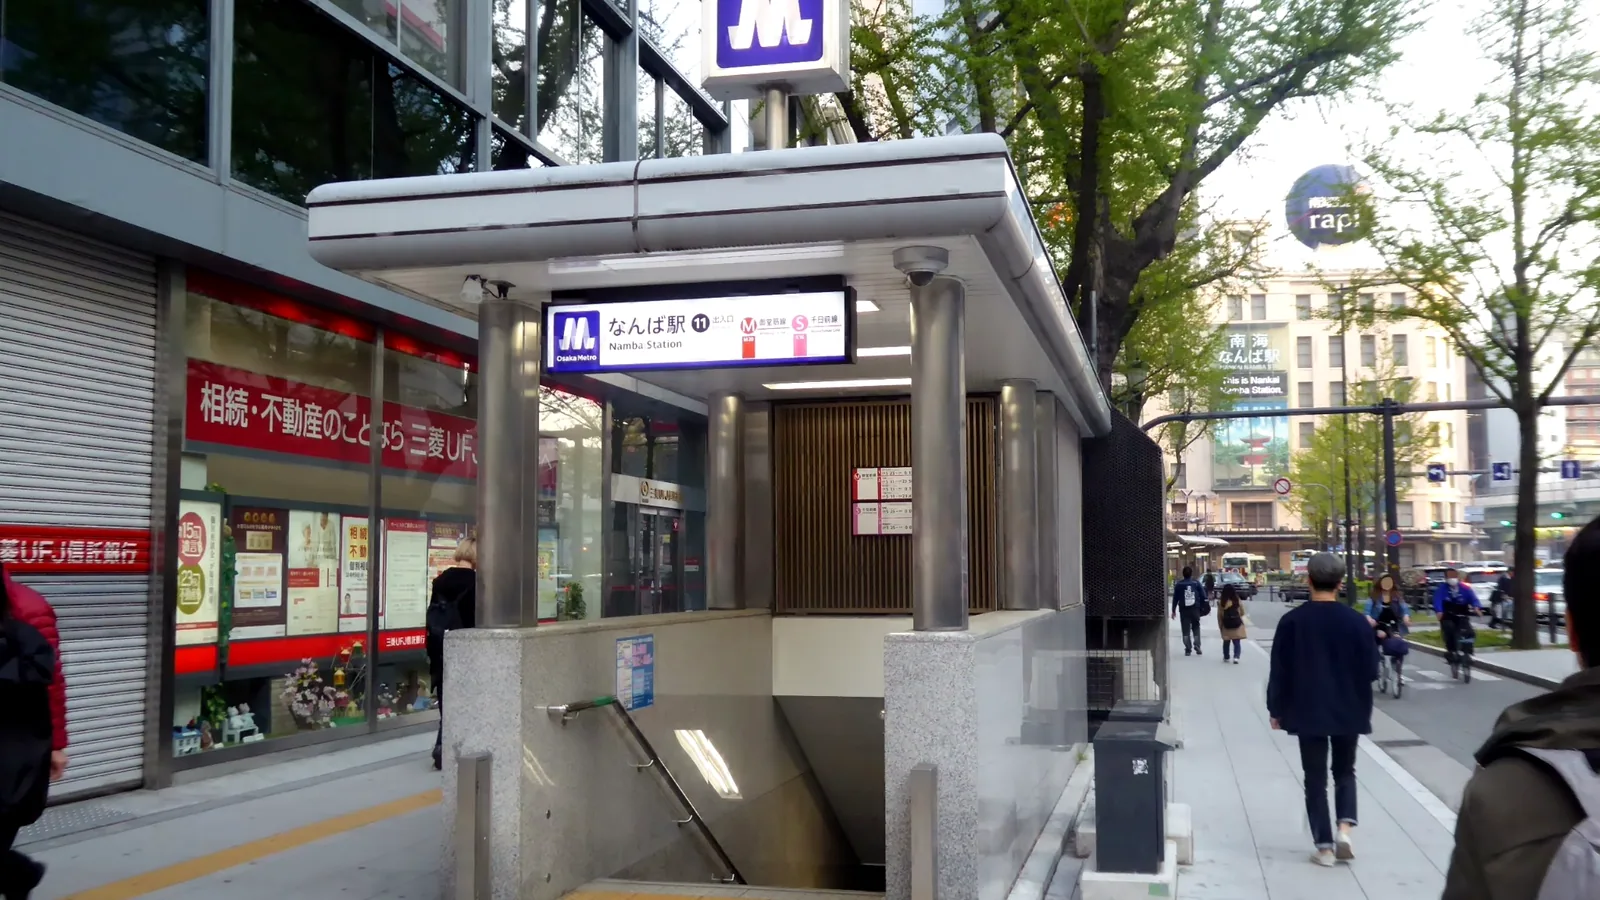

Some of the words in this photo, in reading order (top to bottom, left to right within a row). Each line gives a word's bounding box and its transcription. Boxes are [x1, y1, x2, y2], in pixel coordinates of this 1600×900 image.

[609, 315, 686, 336] なんば駅
[693, 316, 707, 331] 11
[712, 315, 734, 324] 出入口
[741, 318, 757, 334] M
[793, 316, 808, 332] S
[811, 314, 838, 324] 千日前線
[609, 342, 644, 351] Namba
[647, 341, 683, 351] Station
[1228, 334, 1268, 348] 南海
[1219, 349, 1280, 364] なんば駅
[1250, 376, 1280, 384] Nankai
[1252, 386, 1283, 394] Station.
